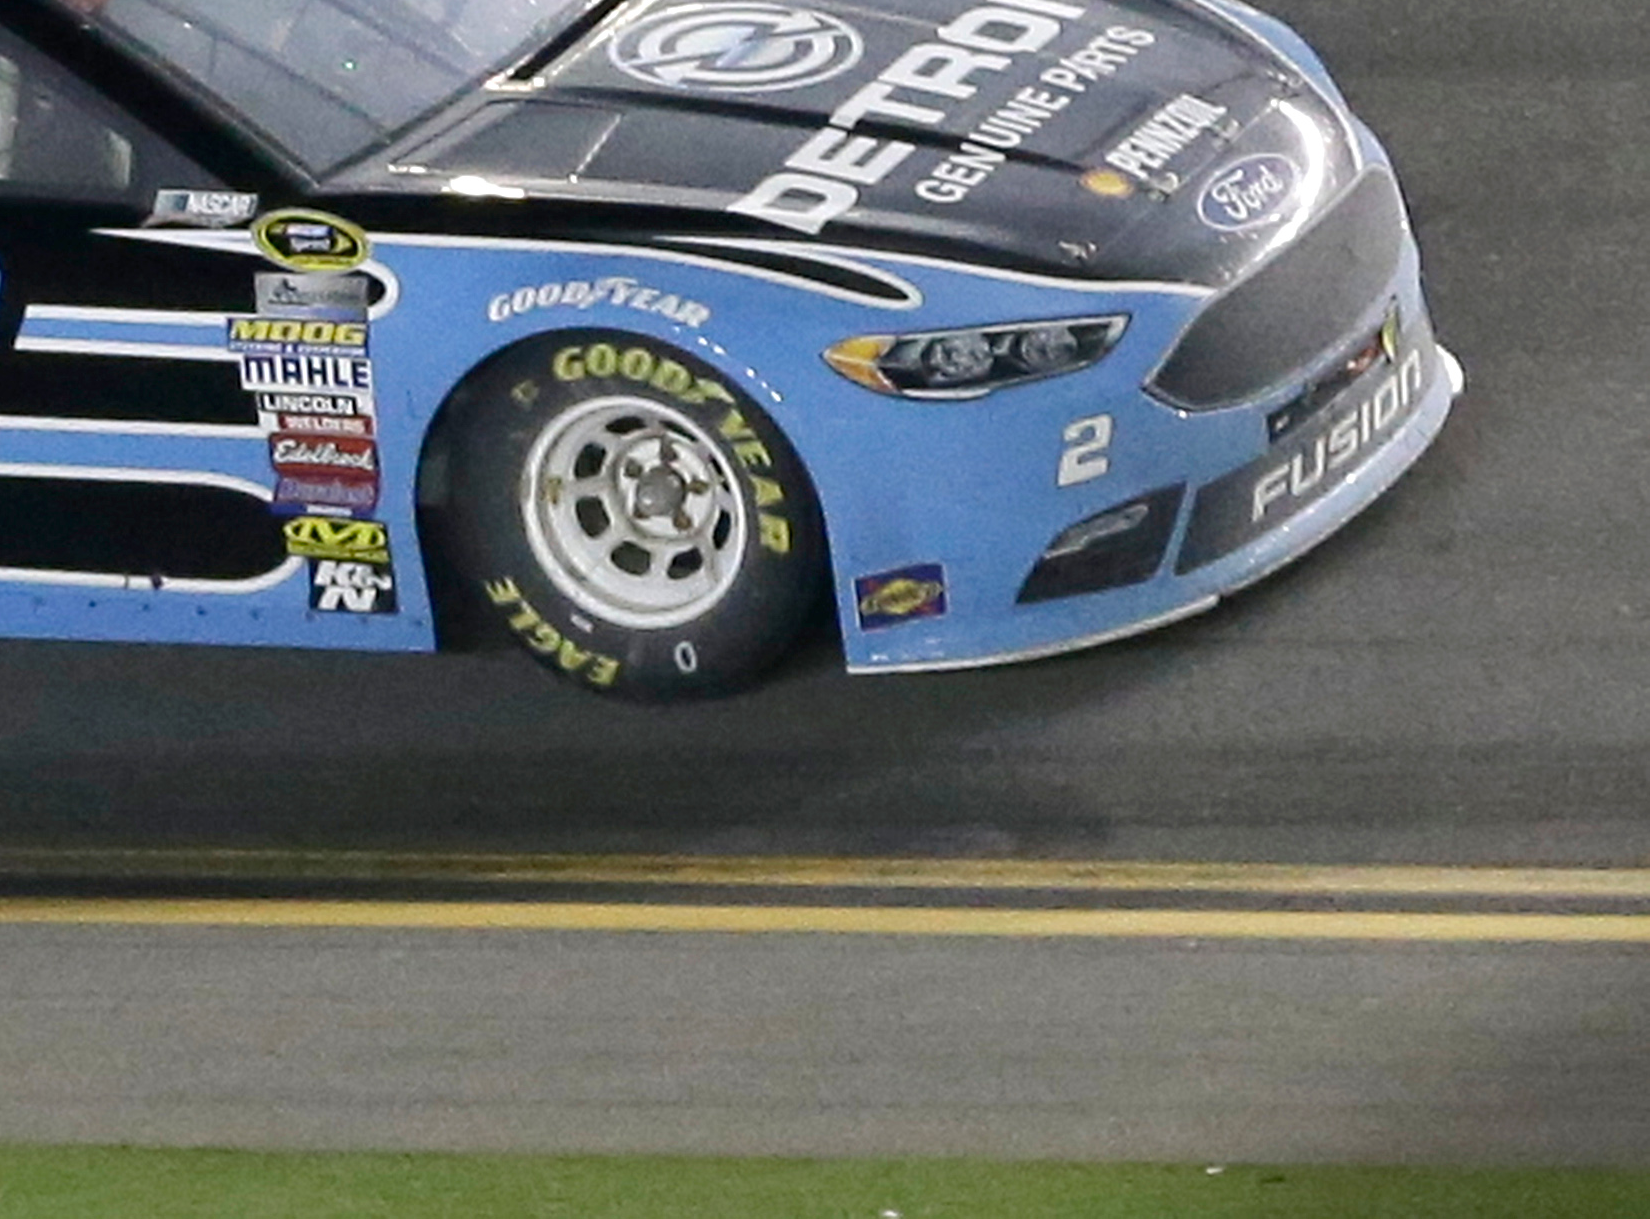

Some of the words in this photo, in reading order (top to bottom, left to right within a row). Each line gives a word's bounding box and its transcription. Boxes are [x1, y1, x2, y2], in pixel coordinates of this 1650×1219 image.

[914, 85, 1071, 204] GENUINE
[1039, 25, 1155, 93] PARTS
[1104, 92, 1228, 180] PENNZOIL
[487, 277, 712, 328] GOODYEAR
[229, 318, 367, 347] MOOG
[244, 355, 370, 390] MAHLE
[262, 392, 354, 415] LINCOLN
[273, 439, 374, 471] Edelbrock
[1056, 412, 1114, 487] 2
[1252, 348, 1422, 522] FUSION
